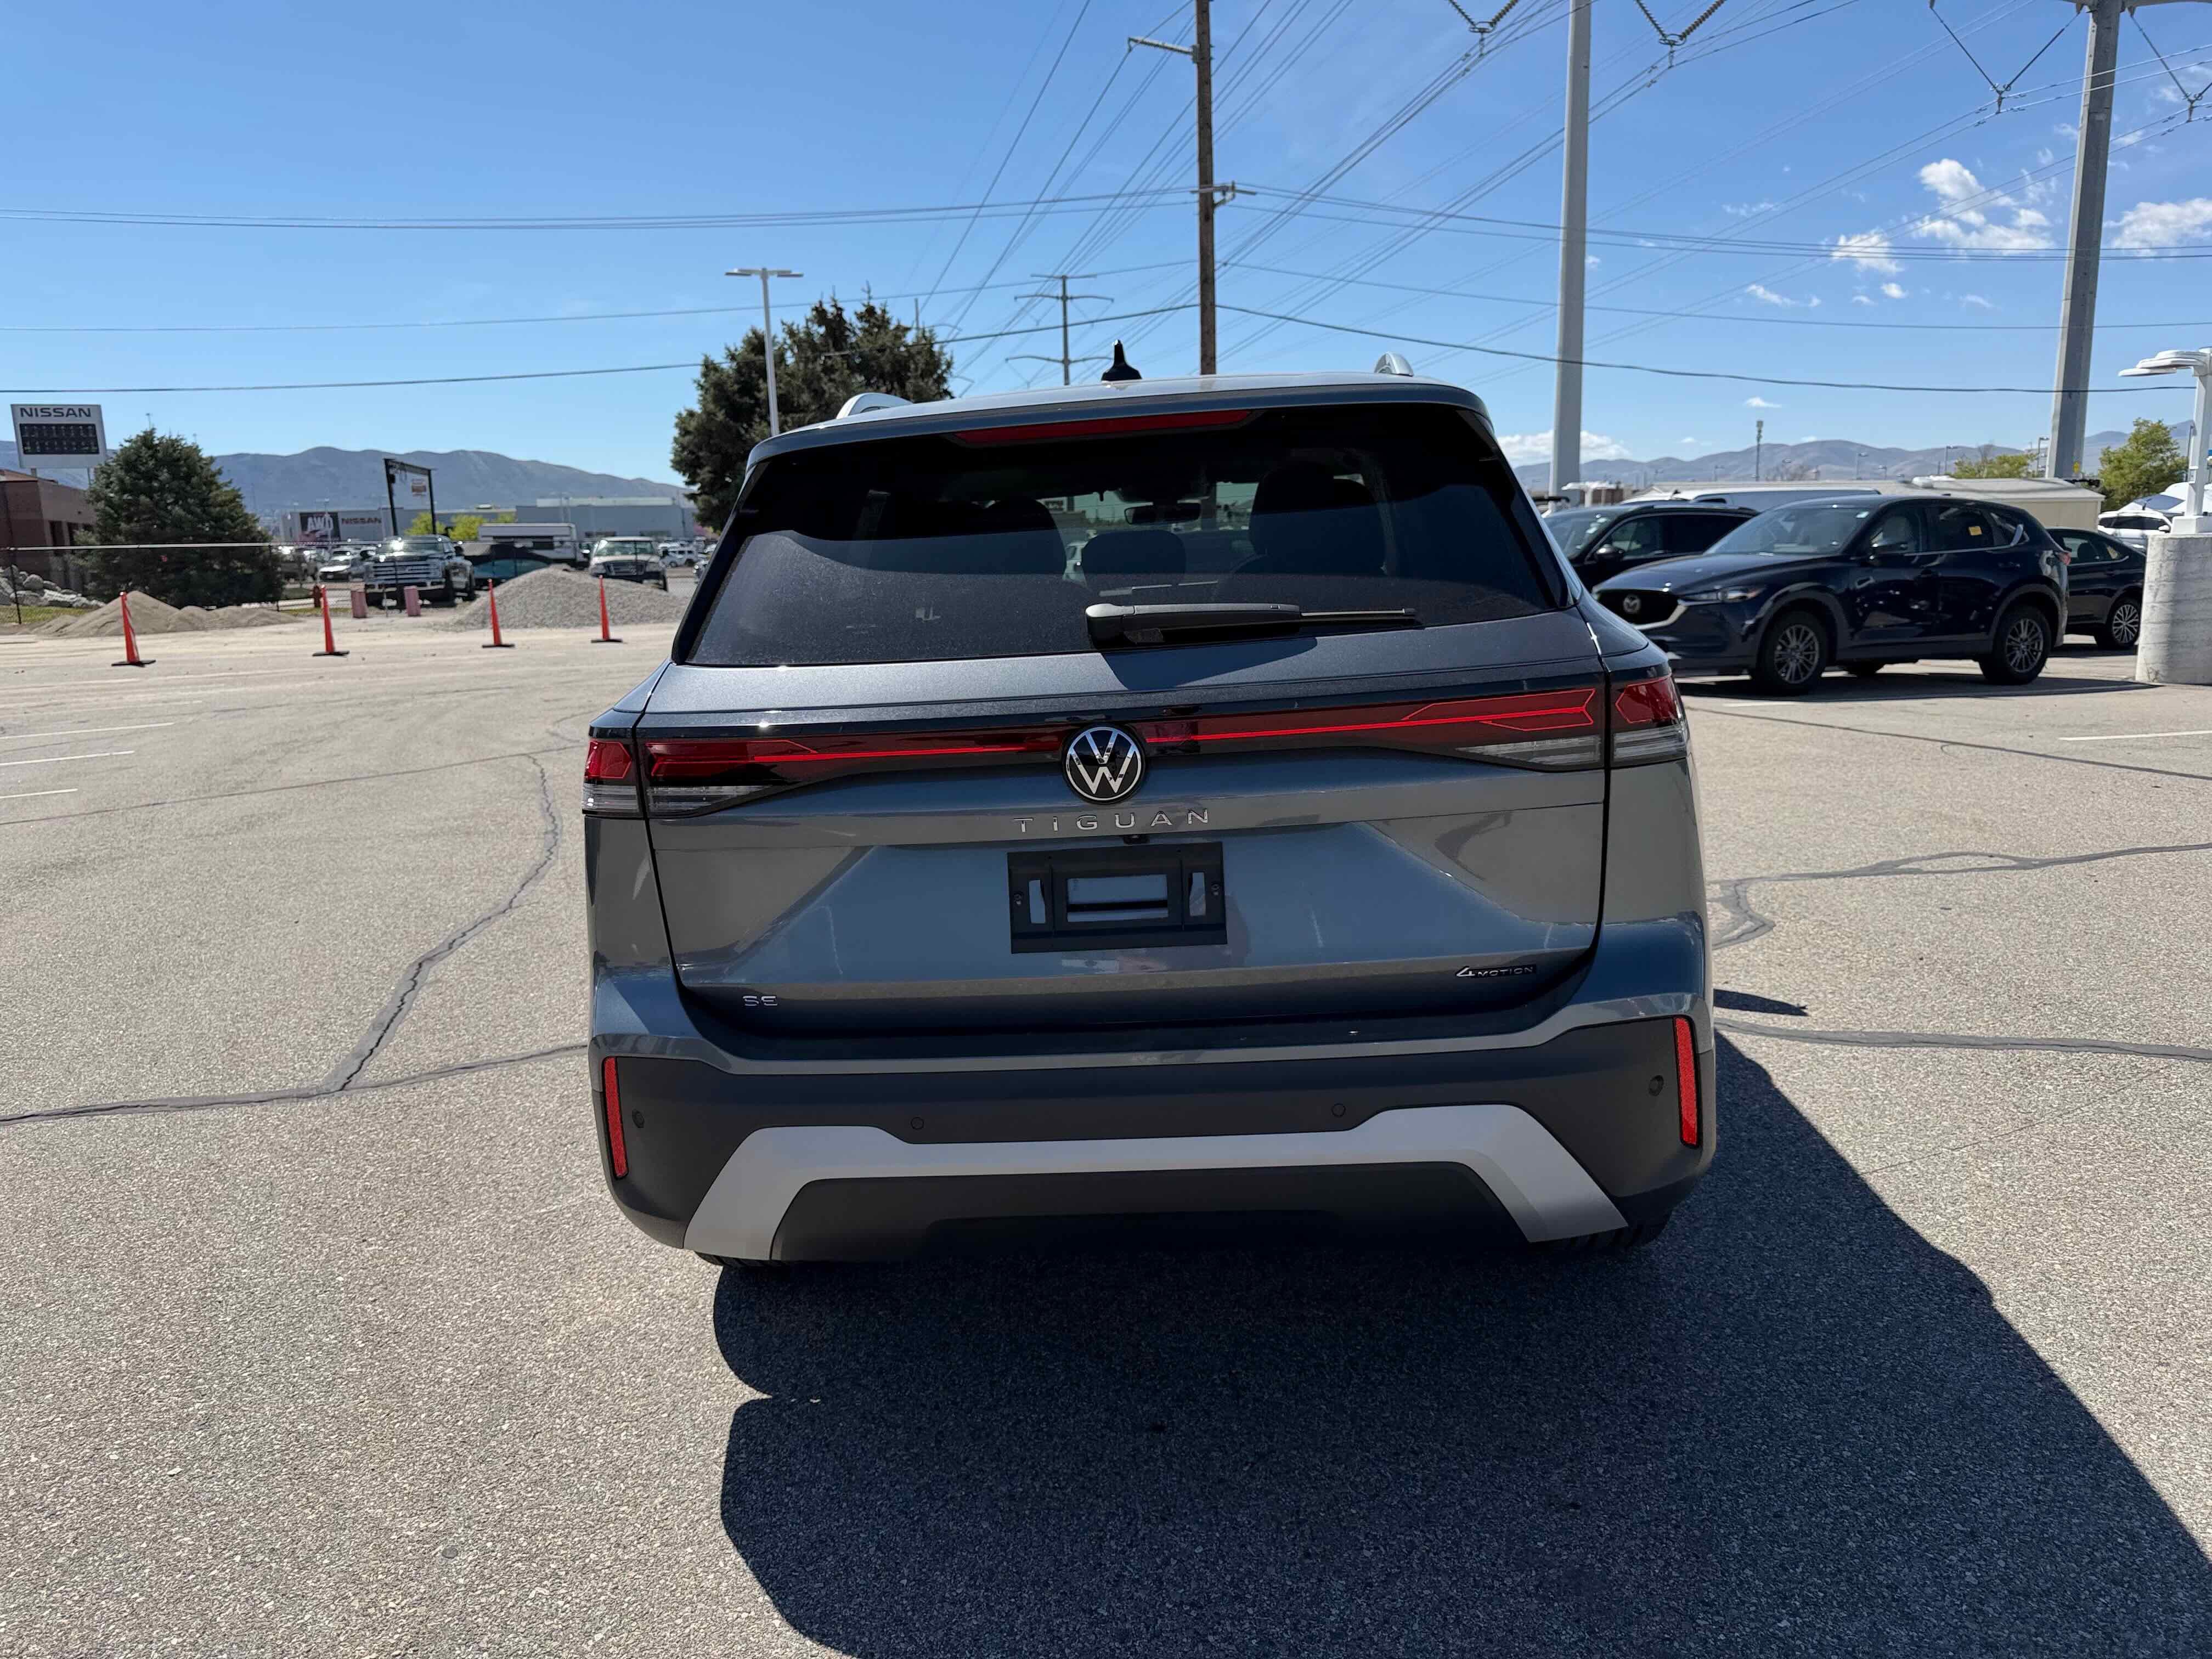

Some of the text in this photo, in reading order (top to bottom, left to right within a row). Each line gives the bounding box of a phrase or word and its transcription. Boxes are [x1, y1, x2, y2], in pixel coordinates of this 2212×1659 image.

[20, 408, 92, 417] NISSAN
[1014, 809, 1209, 834] TIGUAN
[742, 995, 778, 1006] SE
